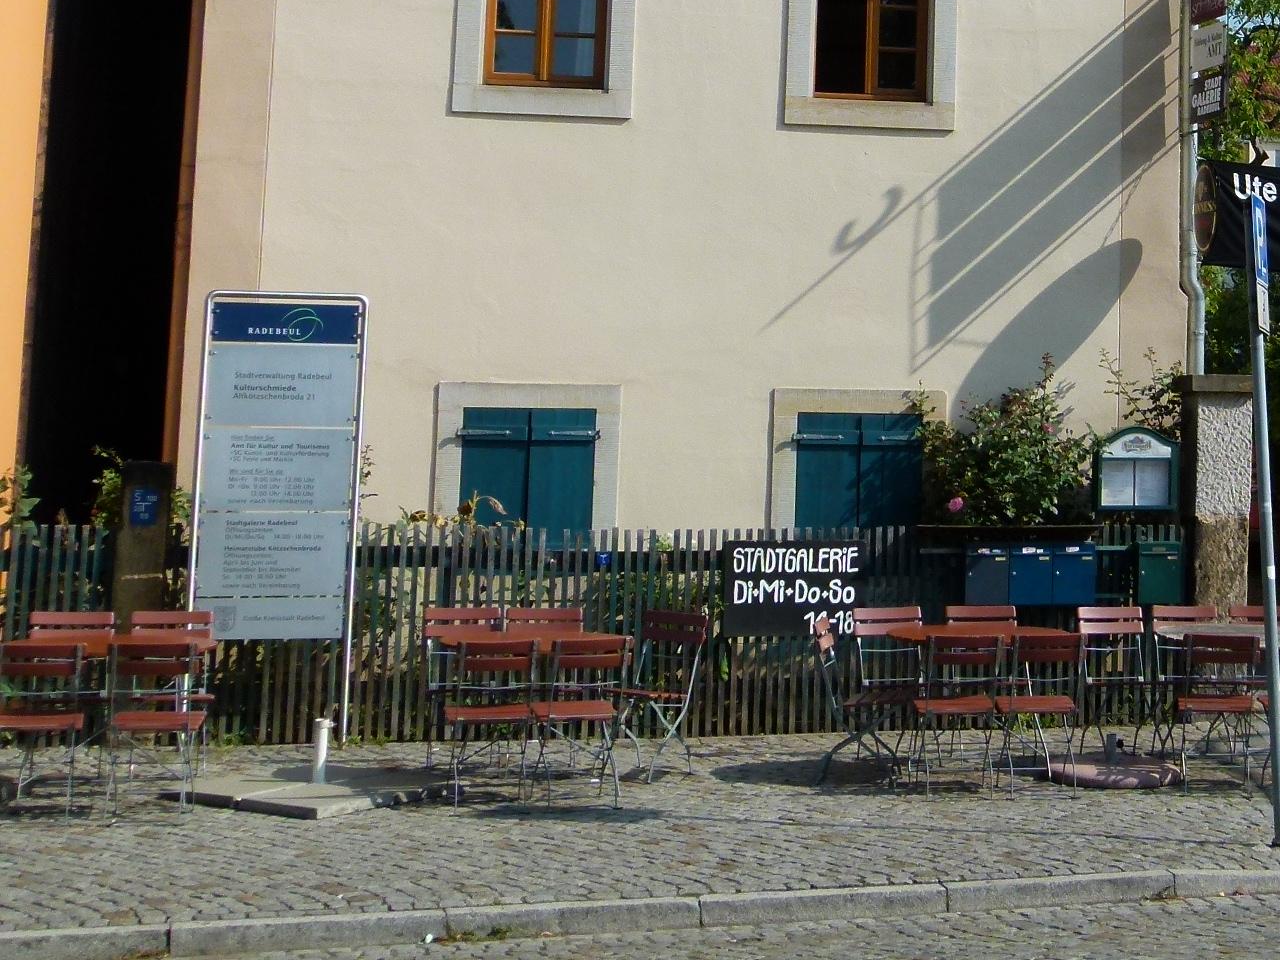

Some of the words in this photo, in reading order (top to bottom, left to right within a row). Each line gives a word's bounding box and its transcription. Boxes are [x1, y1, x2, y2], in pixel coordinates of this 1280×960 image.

[1207, 41, 1222, 59] AMT
[1204, 75, 1223, 91] STADT
[1191, 87, 1222, 109] GALERIE
[1233, 172, 1278, 203] Ute
[247, 326, 302, 336] RADEBEUL
[233, 371, 296, 382] Stadtverwaltung
[297, 371, 333, 381] Radebeul
[233, 384, 297, 392] Kulturschmiede
[306, 393, 316, 401] 21
